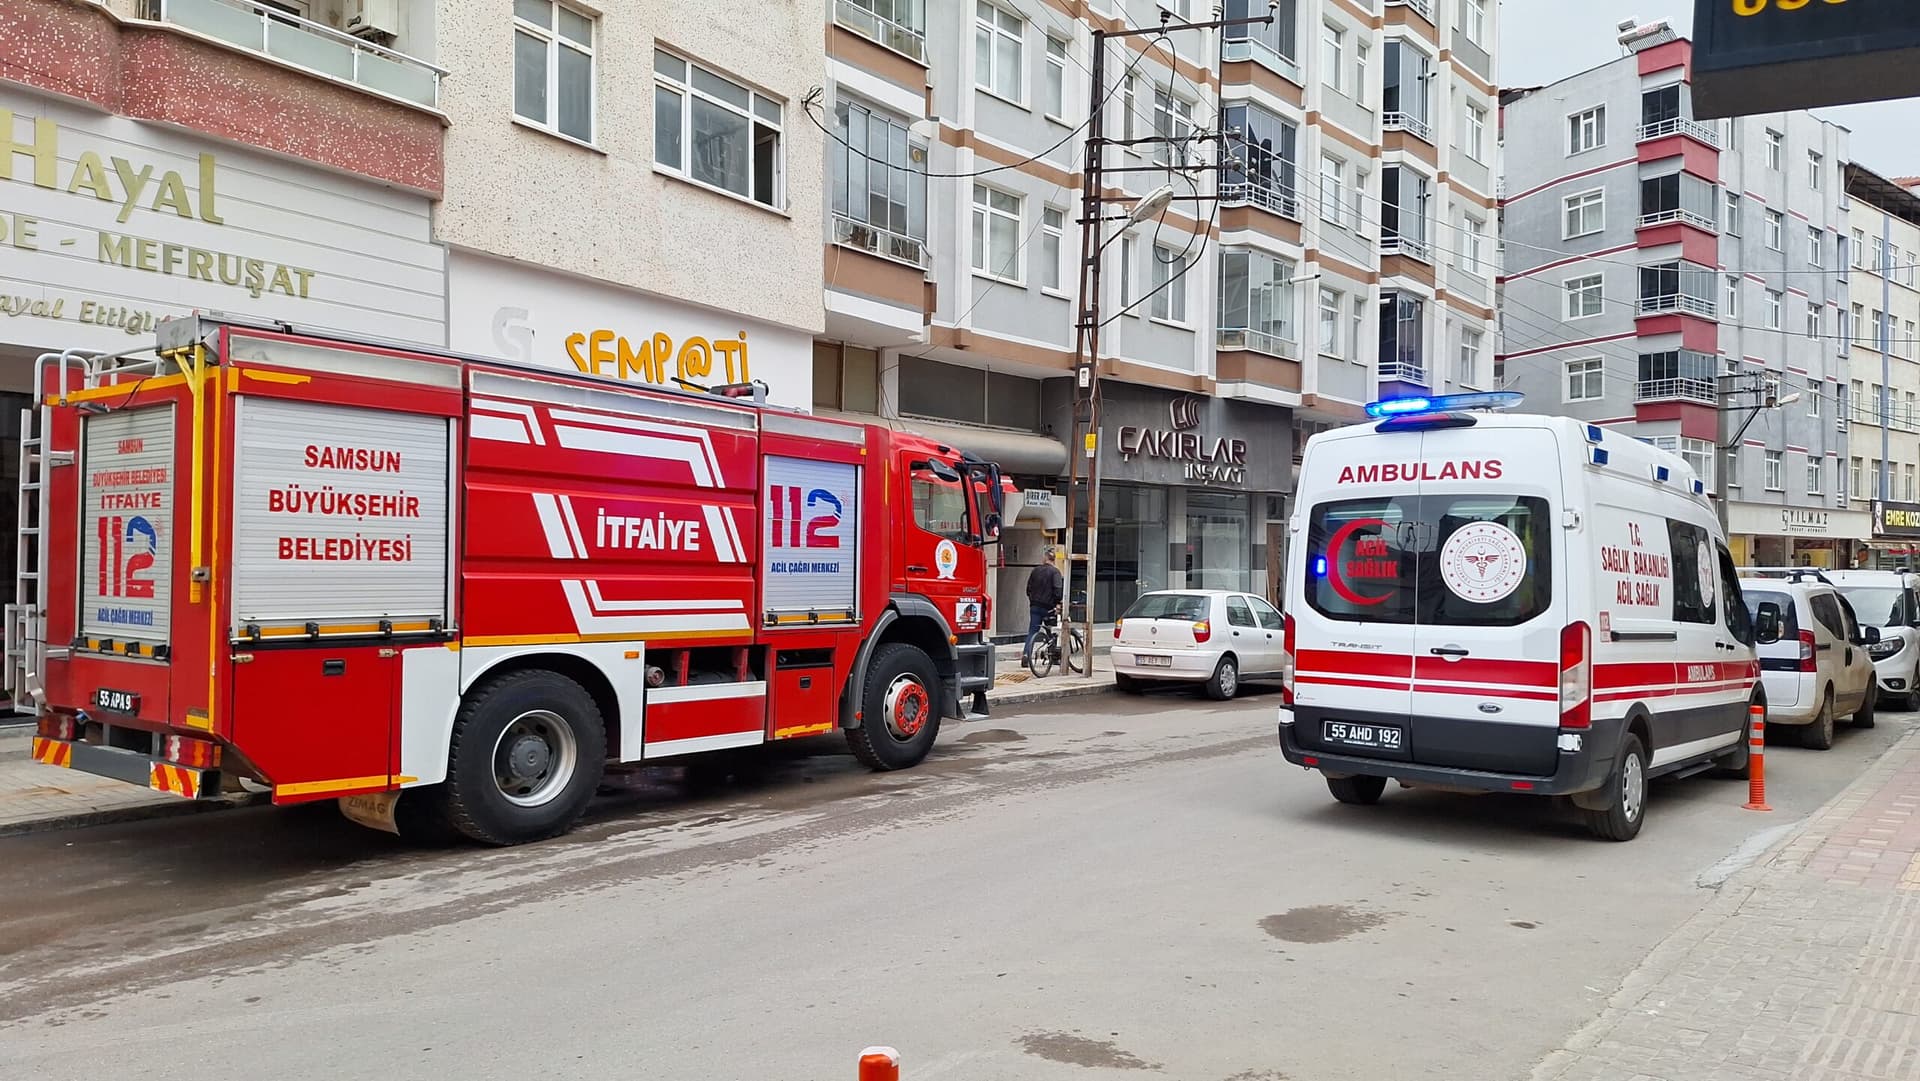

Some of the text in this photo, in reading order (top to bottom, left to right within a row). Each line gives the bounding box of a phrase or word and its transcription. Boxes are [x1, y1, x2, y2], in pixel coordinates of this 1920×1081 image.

[98, 231, 315, 298] MEFRUŞAT
[1117, 426, 1247, 465] ÇAKIRLAR
[304, 445, 401, 473] SAMSUN
[1337, 460, 1503, 484] AMBULANS
[1184, 463, 1246, 485] İNŞAAT
[269, 484, 420, 521] BÜYÜKŞEHİR
[597, 507, 700, 551] İTFAİYE
[770, 485, 842, 548] 112
[1790, 510, 1828, 525] YILMAZ
[1885, 509, 1905, 526] EMRE
[278, 533, 412, 561] BELEDİYESİ
[1628, 523, 1643, 547] T.C.
[98, 515, 157, 598] 112
[771, 561, 840, 575] ACİL ÇAĞRI MERKEZİ
[1345, 558, 1398, 577] SAĞLIK
[1601, 545, 1670, 579] SAĞLIK BAKANLIĞI
[1616, 577, 1660, 606] ACİL SAĞLIK
[1687, 665, 1716, 681] AMBULANS
[100, 690, 131, 710] 55 APA 9
[1331, 724, 1346, 738] 55
[1349, 726, 1372, 740] AHD
[1378, 729, 1399, 744] 192
